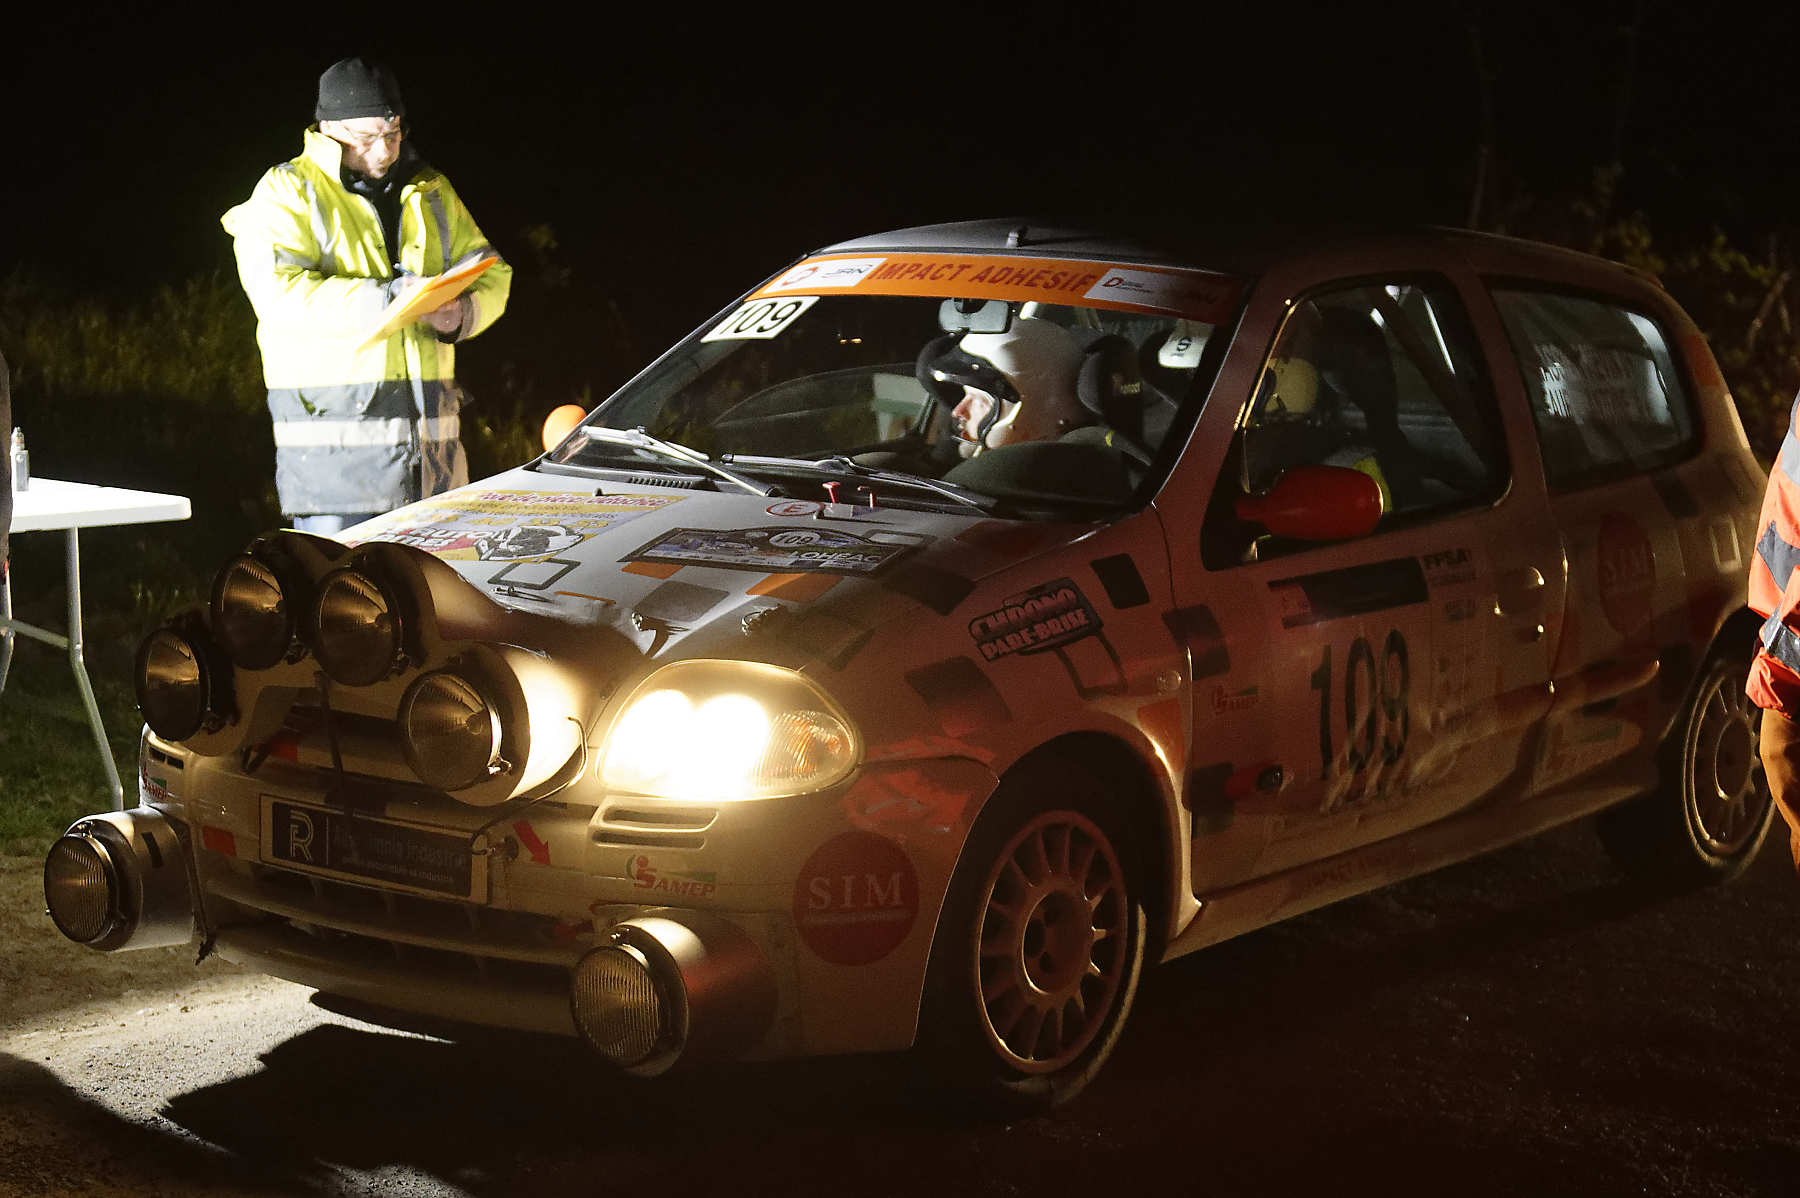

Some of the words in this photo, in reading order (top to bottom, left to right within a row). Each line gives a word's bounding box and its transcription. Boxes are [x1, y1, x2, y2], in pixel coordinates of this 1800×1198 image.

[866, 263, 972, 281] IMPACT
[720, 301, 803, 335] 109
[777, 534, 814, 545] 109
[1311, 629, 1409, 781] 109
[632, 867, 716, 896] SAMEP
[807, 872, 904, 910] SIM
